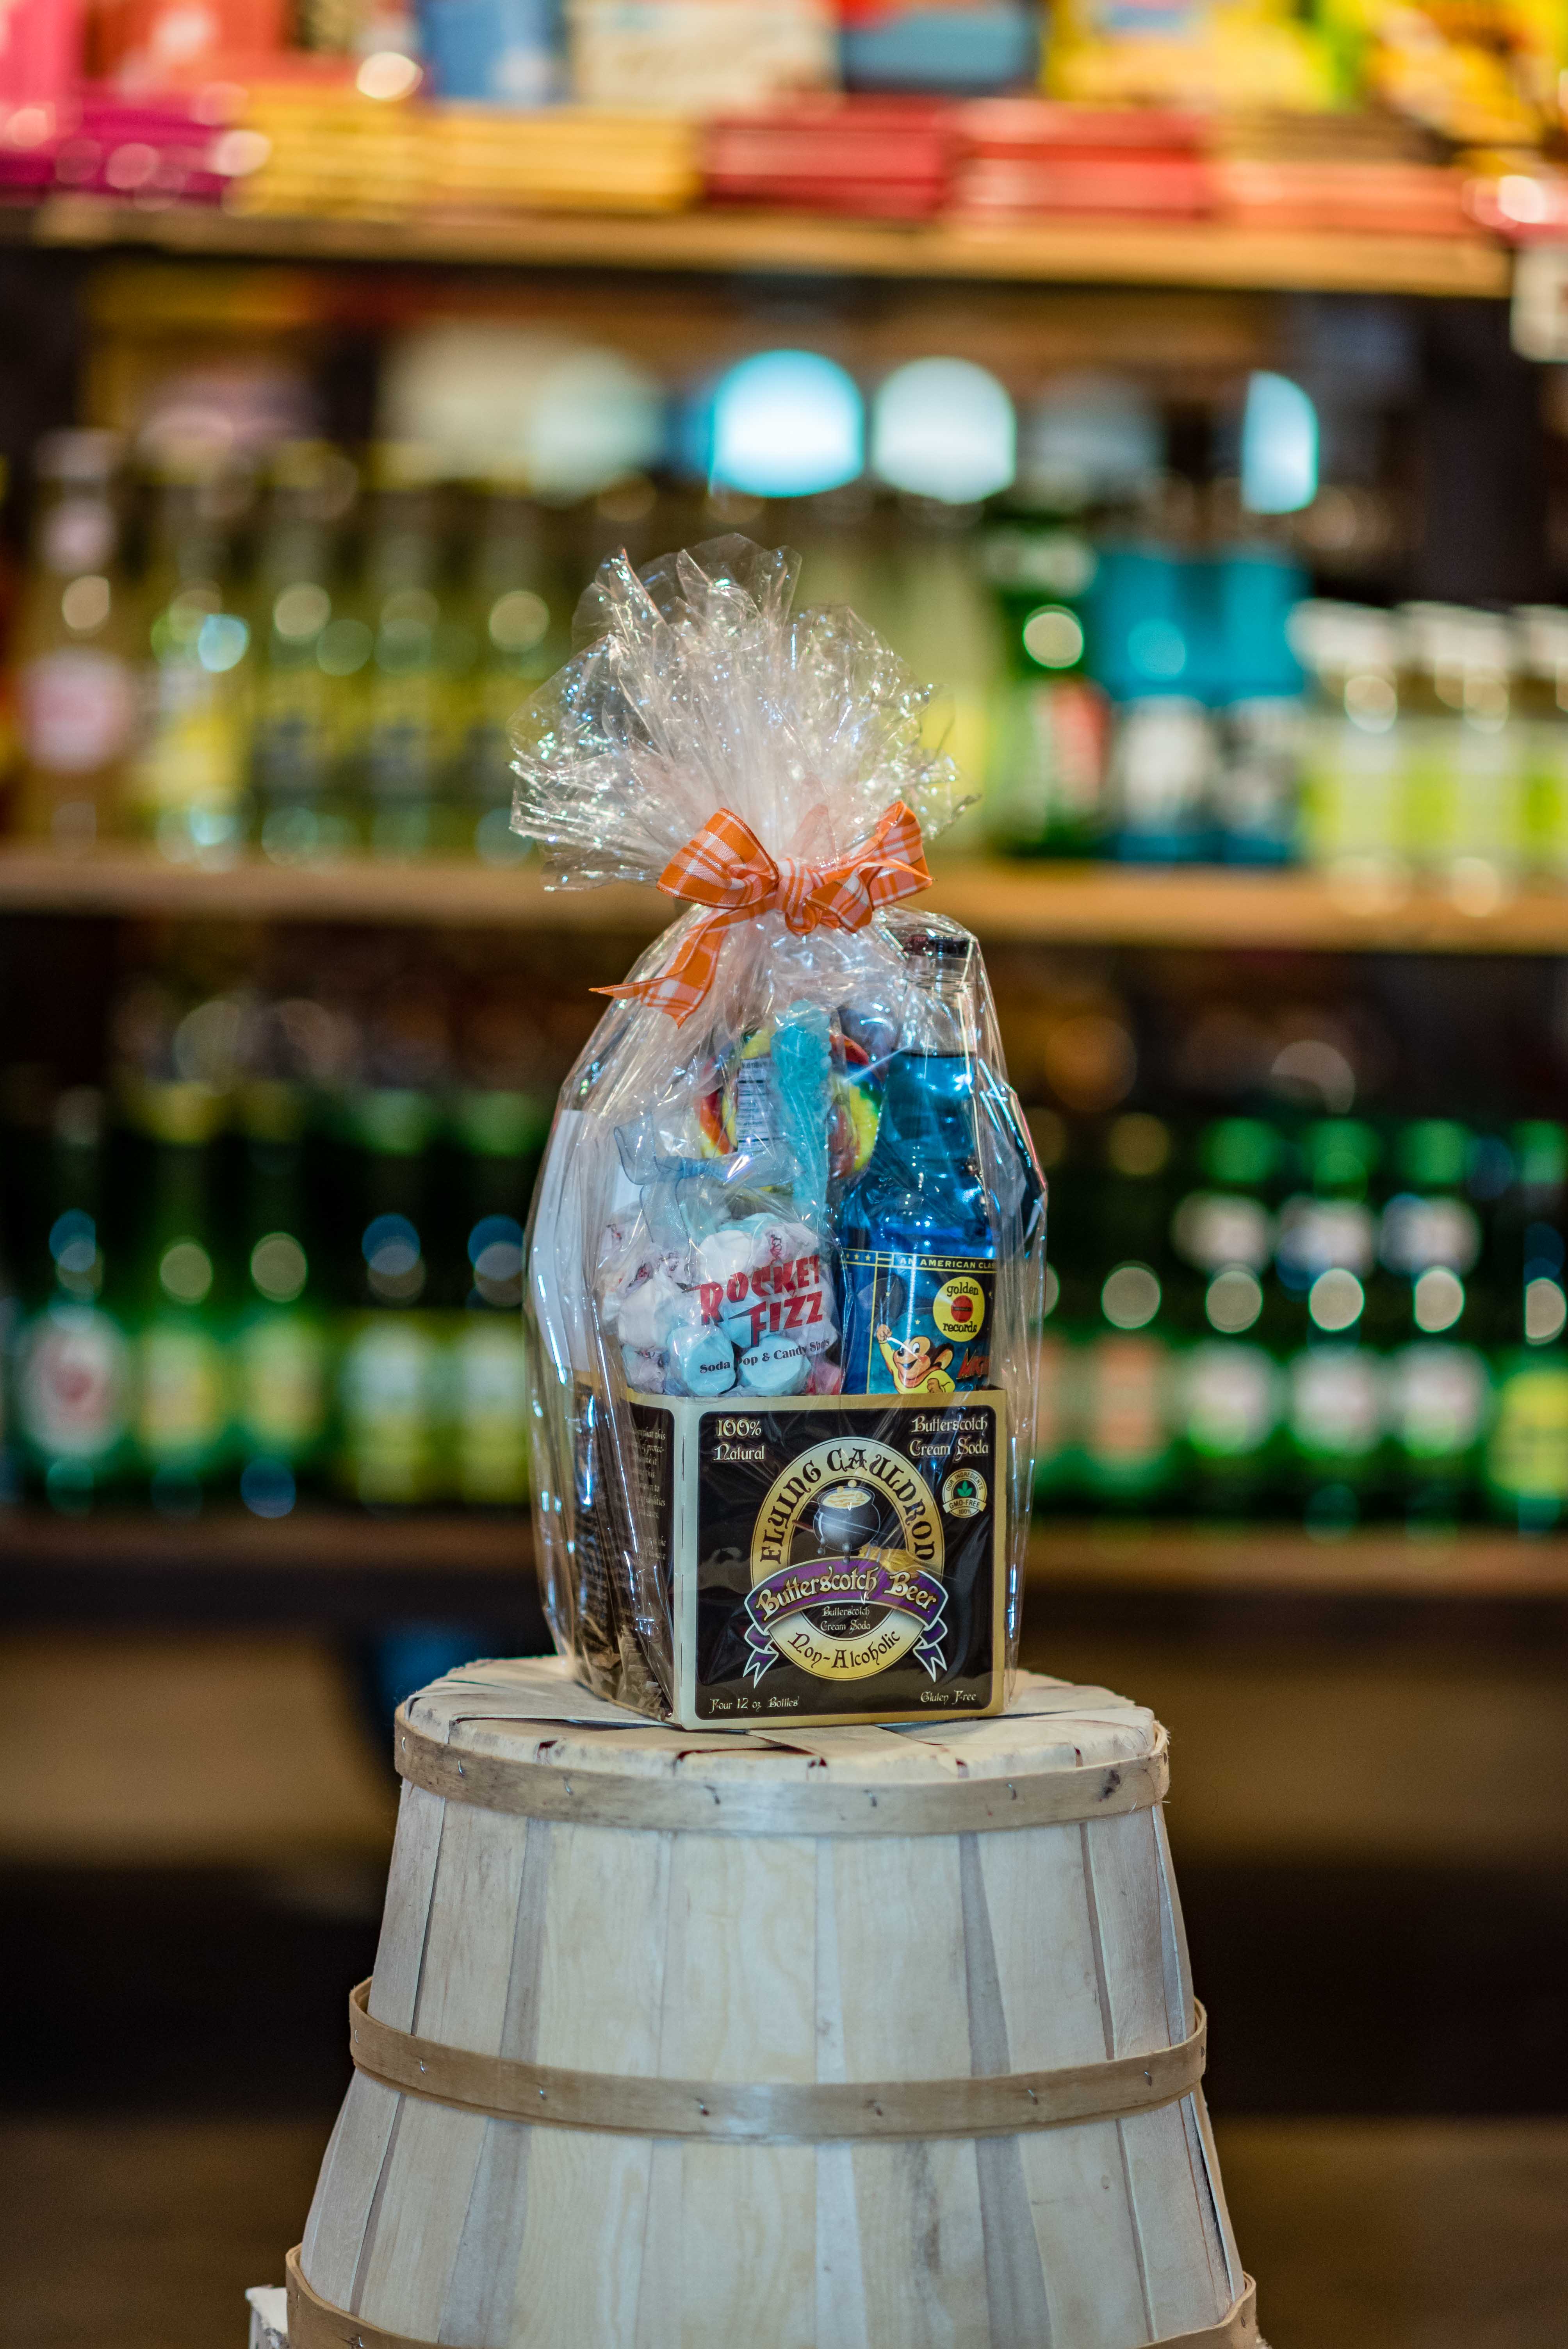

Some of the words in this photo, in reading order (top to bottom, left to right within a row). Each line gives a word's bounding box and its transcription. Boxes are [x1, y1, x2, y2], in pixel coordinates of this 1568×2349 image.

[920, 1259, 975, 1268] AMERICAN
[682, 1255, 820, 1326] ROCKET
[946, 1282, 979, 1297] golden
[728, 1291, 823, 1348] FIZZ
[943, 1321, 977, 1333] records
[700, 1361, 731, 1374] Soda
[762, 1352, 770, 1362] &
[773, 1345, 806, 1360] Candy
[717, 1419, 762, 1436] 100%
[911, 1414, 987, 1436] Butterscotch
[713, 1443, 764, 1460] Natural
[909, 1439, 951, 1456] Cream
[955, 1436, 989, 1461] Soda
[946, 1480, 954, 1492] OUR
[955, 1472, 984, 1490] INGREDIENTS
[761, 1460, 821, 1565] FLYING
[826, 1447, 935, 1561] CAULDRON
[949, 1499, 981, 1509] GMO-FREE
[755, 1566, 879, 1621] Butterscotch
[884, 1571, 937, 1610] Beer
[821, 1605, 870, 1619] Butterscotch
[820, 1620, 846, 1631] Cream
[849, 1618, 871, 1634] Soda
[787, 1631, 900, 1669] Non-Alcoholic
[709, 1698, 732, 1714] Four
[737, 1697, 749, 1709] 12
[767, 1696, 800, 1708] Bottles
[920, 1691, 949, 1705] Gluten
[951, 1690, 976, 1705] Free
